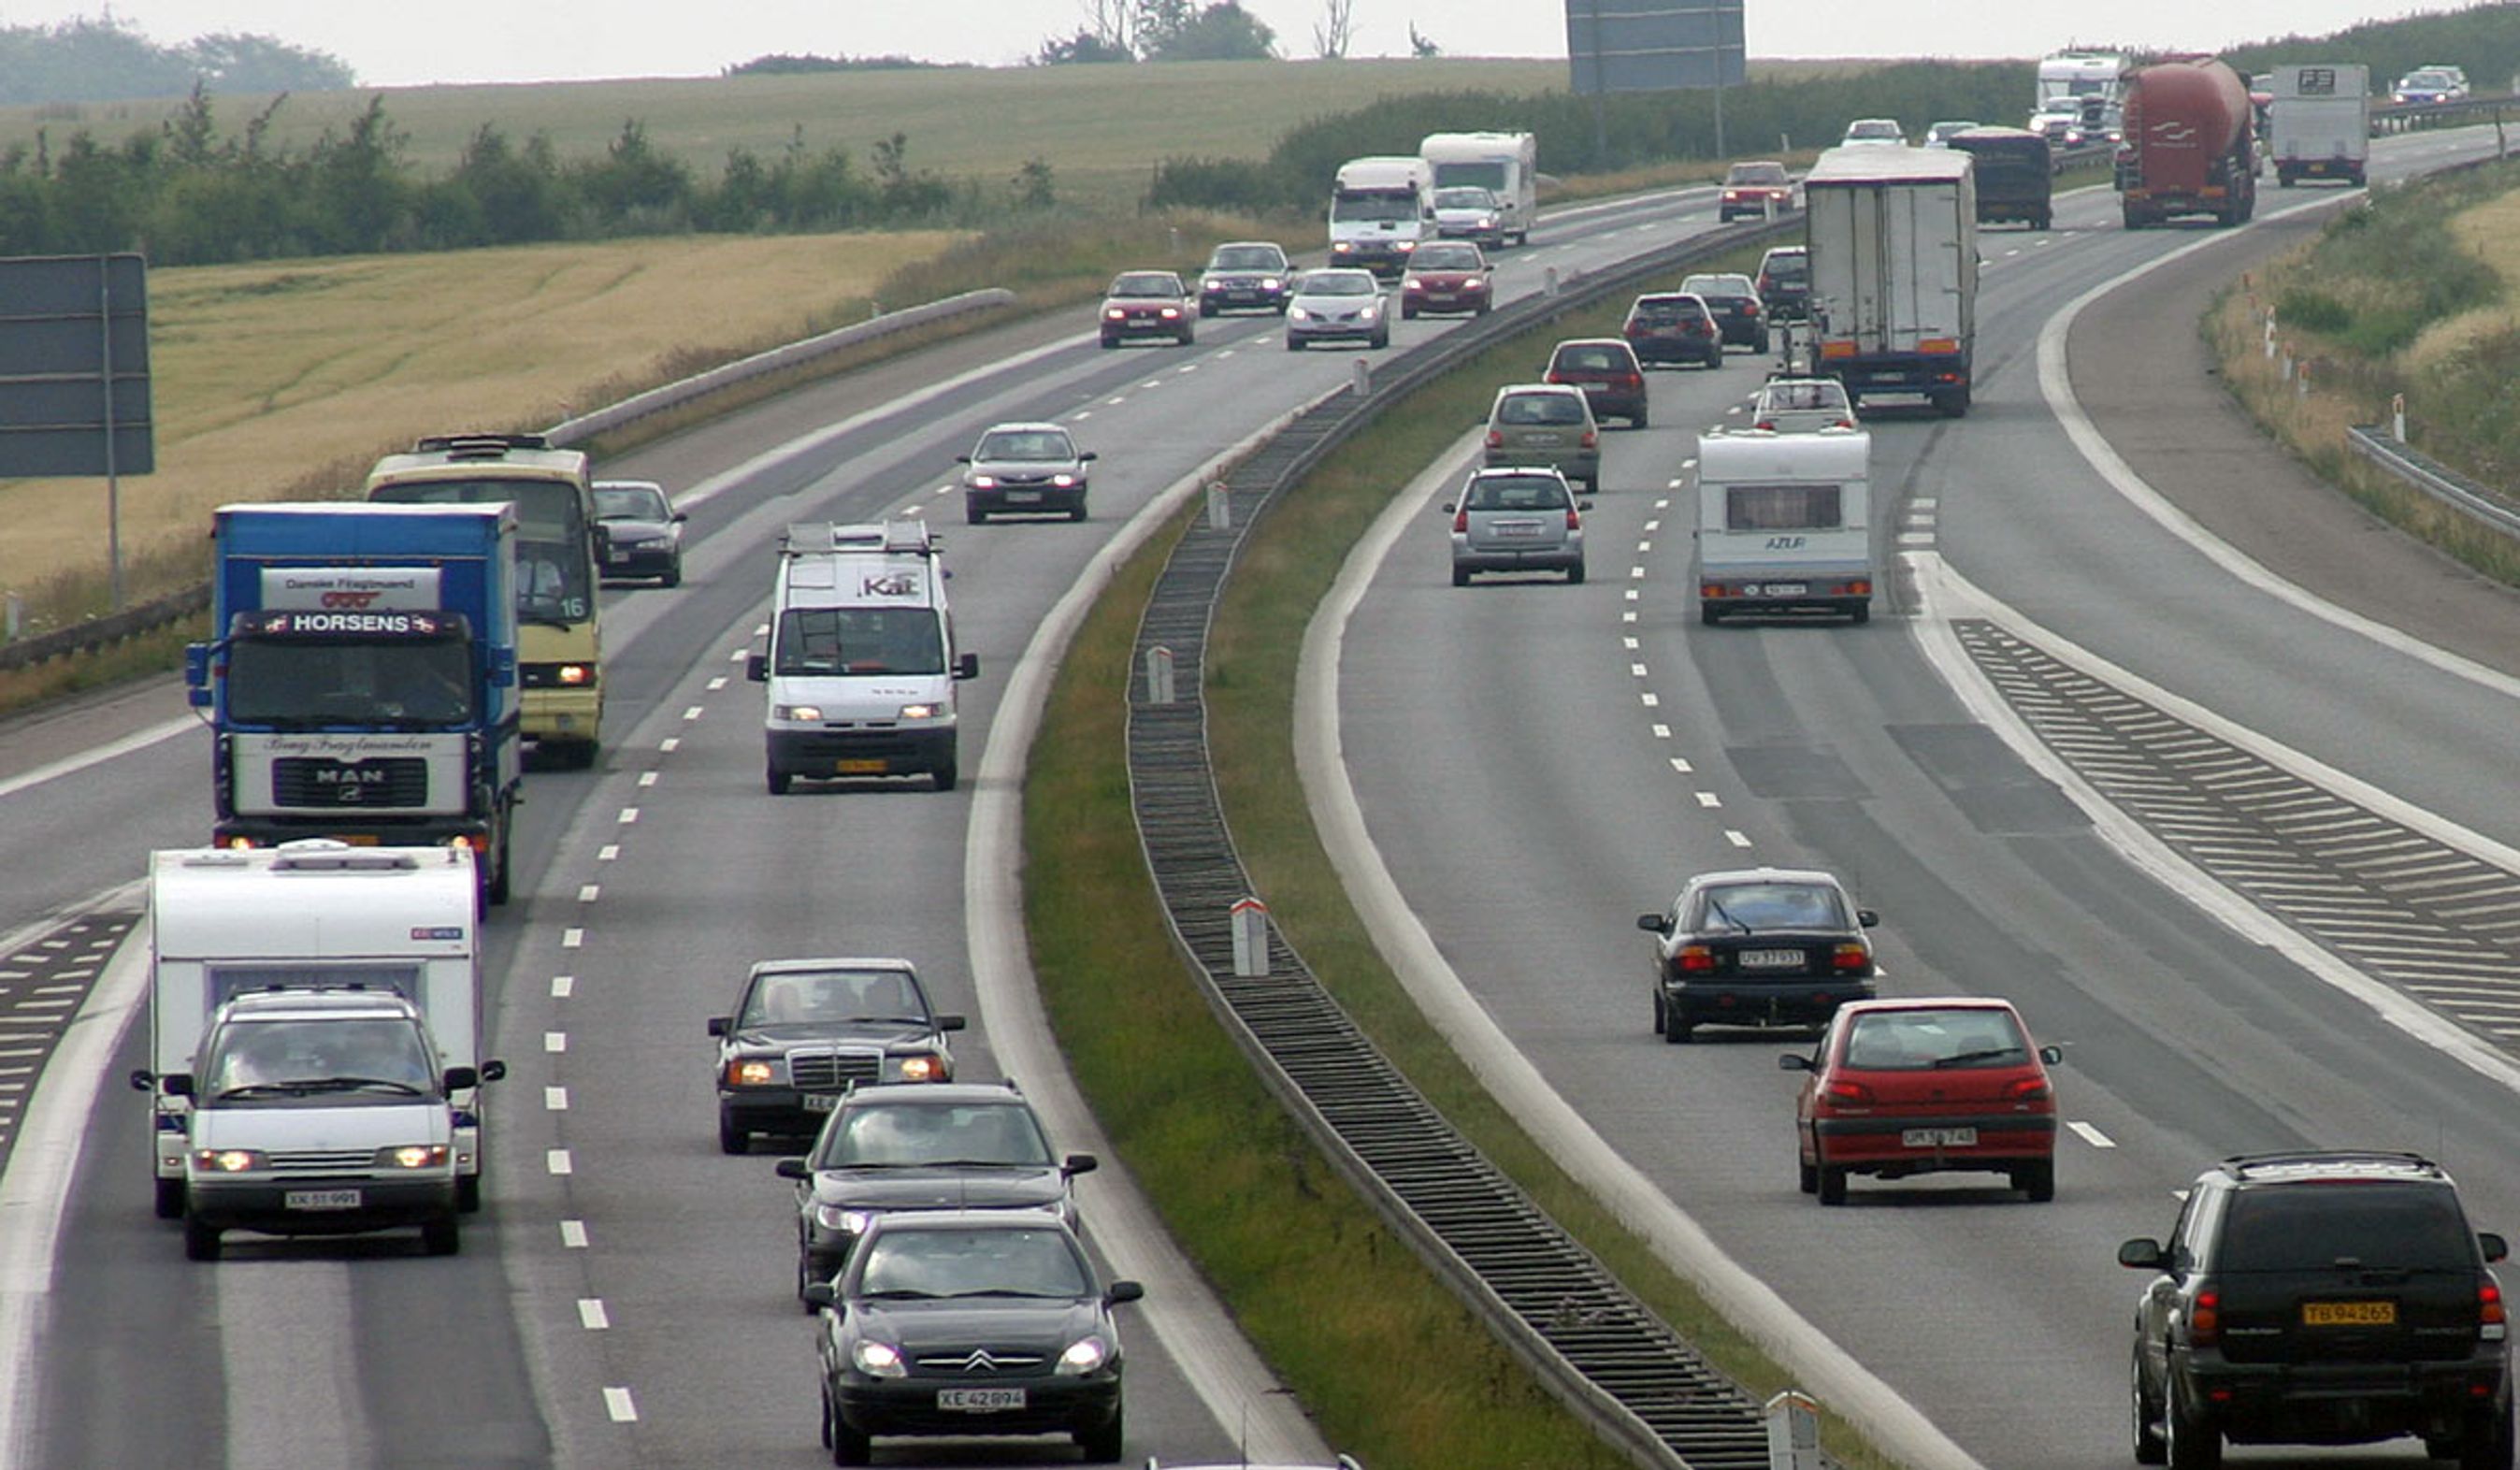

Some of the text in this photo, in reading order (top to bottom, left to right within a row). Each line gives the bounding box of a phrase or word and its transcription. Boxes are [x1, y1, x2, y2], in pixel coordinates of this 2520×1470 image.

[560, 598, 585, 617] 16
[294, 614, 410, 632] HORSENS
[316, 770, 384, 783] MAN
